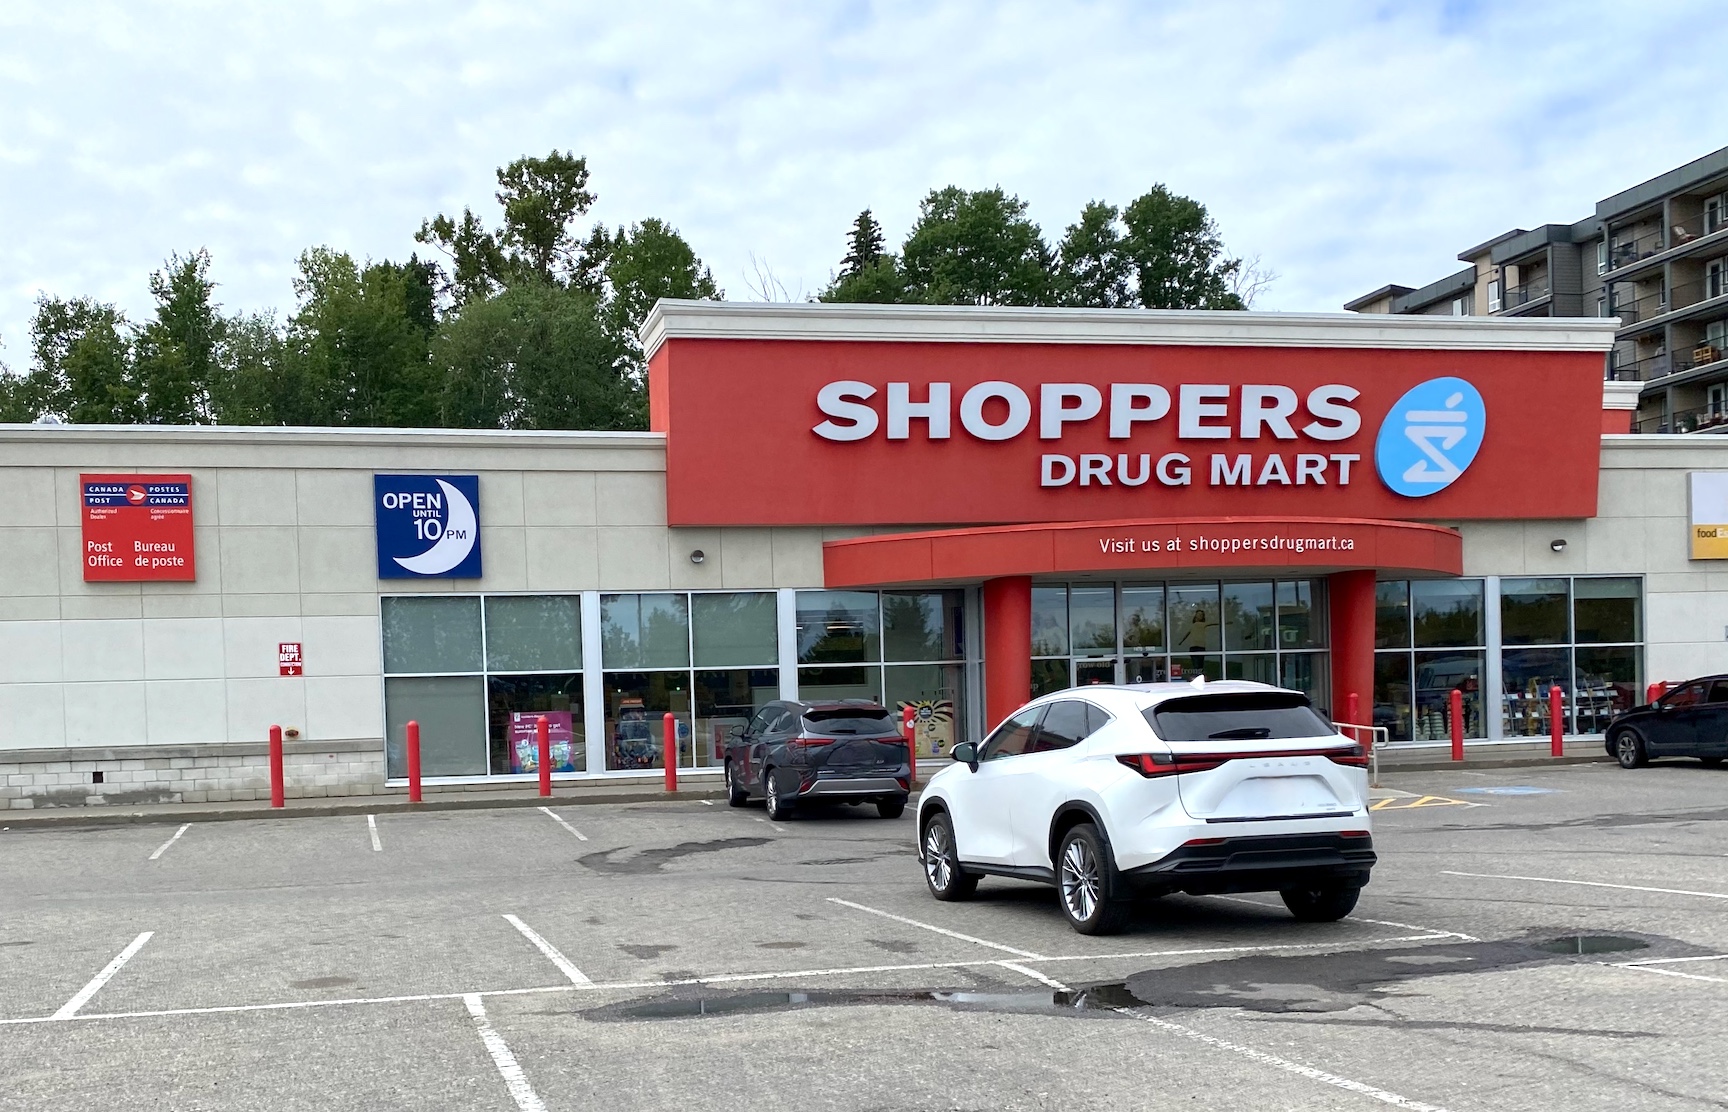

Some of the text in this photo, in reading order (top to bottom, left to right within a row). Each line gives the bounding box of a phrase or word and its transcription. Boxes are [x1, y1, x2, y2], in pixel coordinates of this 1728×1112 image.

[813, 380, 1362, 442] SHOPPERS
[1040, 453, 1361, 487] DRUG MART
[382, 492, 442, 509] OPEN
[412, 510, 442, 518] UNTIL
[413, 518, 467, 541] 10 PM
[87, 541, 113, 552] Post
[134, 541, 175, 552] Bureau
[1099, 536, 1355, 553] Visit us at shoppersdrugmart.ca
[88, 555, 123, 567] Office
[134, 555, 184, 569] de poste
[281, 645, 298, 653] FIRE
[280, 653, 301, 661] DEPT.
